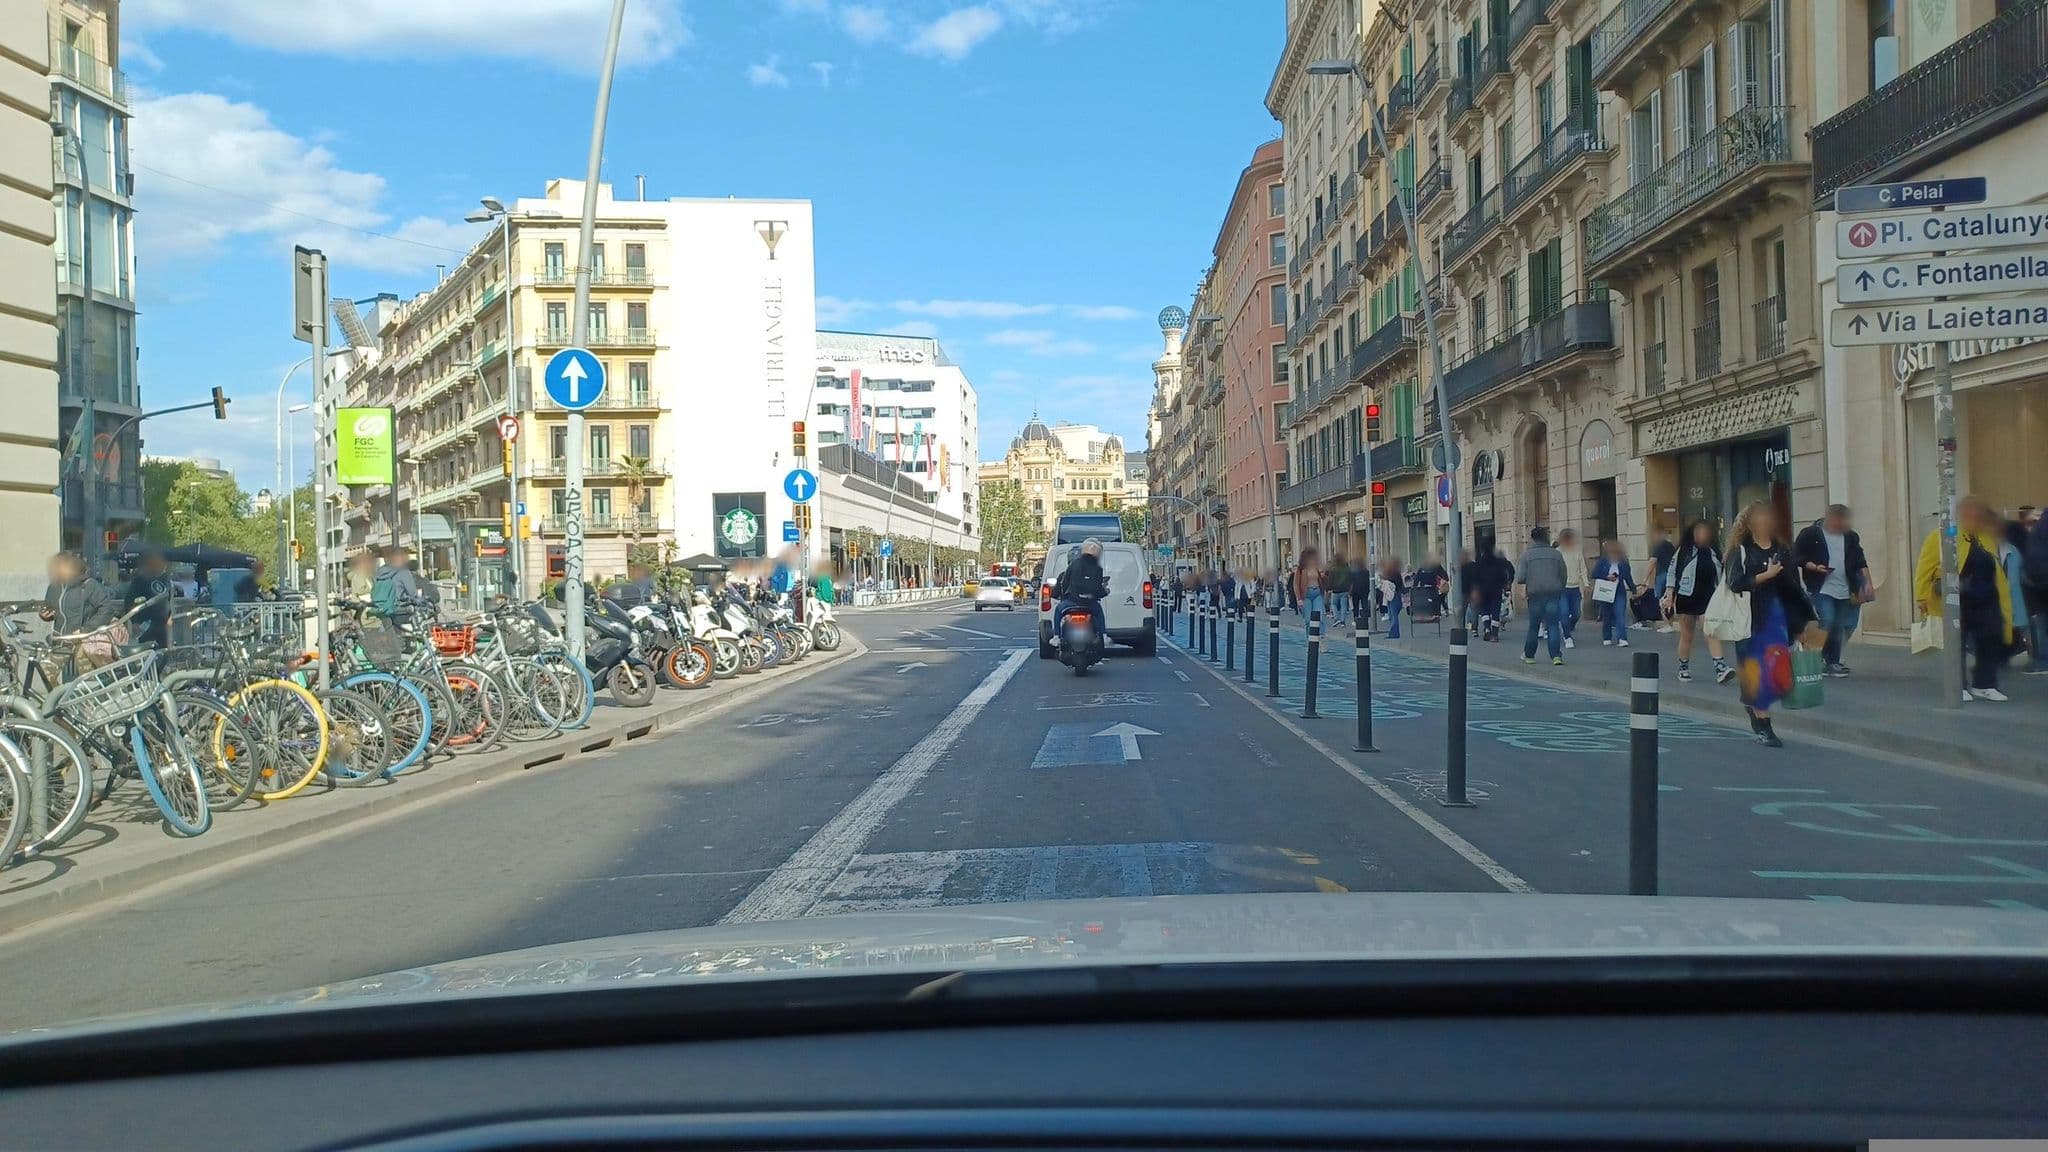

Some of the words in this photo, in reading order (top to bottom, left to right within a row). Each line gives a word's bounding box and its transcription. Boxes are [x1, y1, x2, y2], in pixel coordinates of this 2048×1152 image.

[1878, 188, 1896, 202] C.
[1902, 184, 1944, 201] Pelai
[1881, 221, 1913, 244] Pl.
[1923, 213, 2048, 241] Cataluny
[1882, 266, 1907, 289] C.
[1917, 256, 2048, 287] Fontanella
[1876, 311, 1917, 333] Via
[1927, 306, 2048, 330] Laietana
[879, 344, 925, 365] fnac
[354, 437, 375, 446] FGC
[1690, 487, 1704, 499] 32
